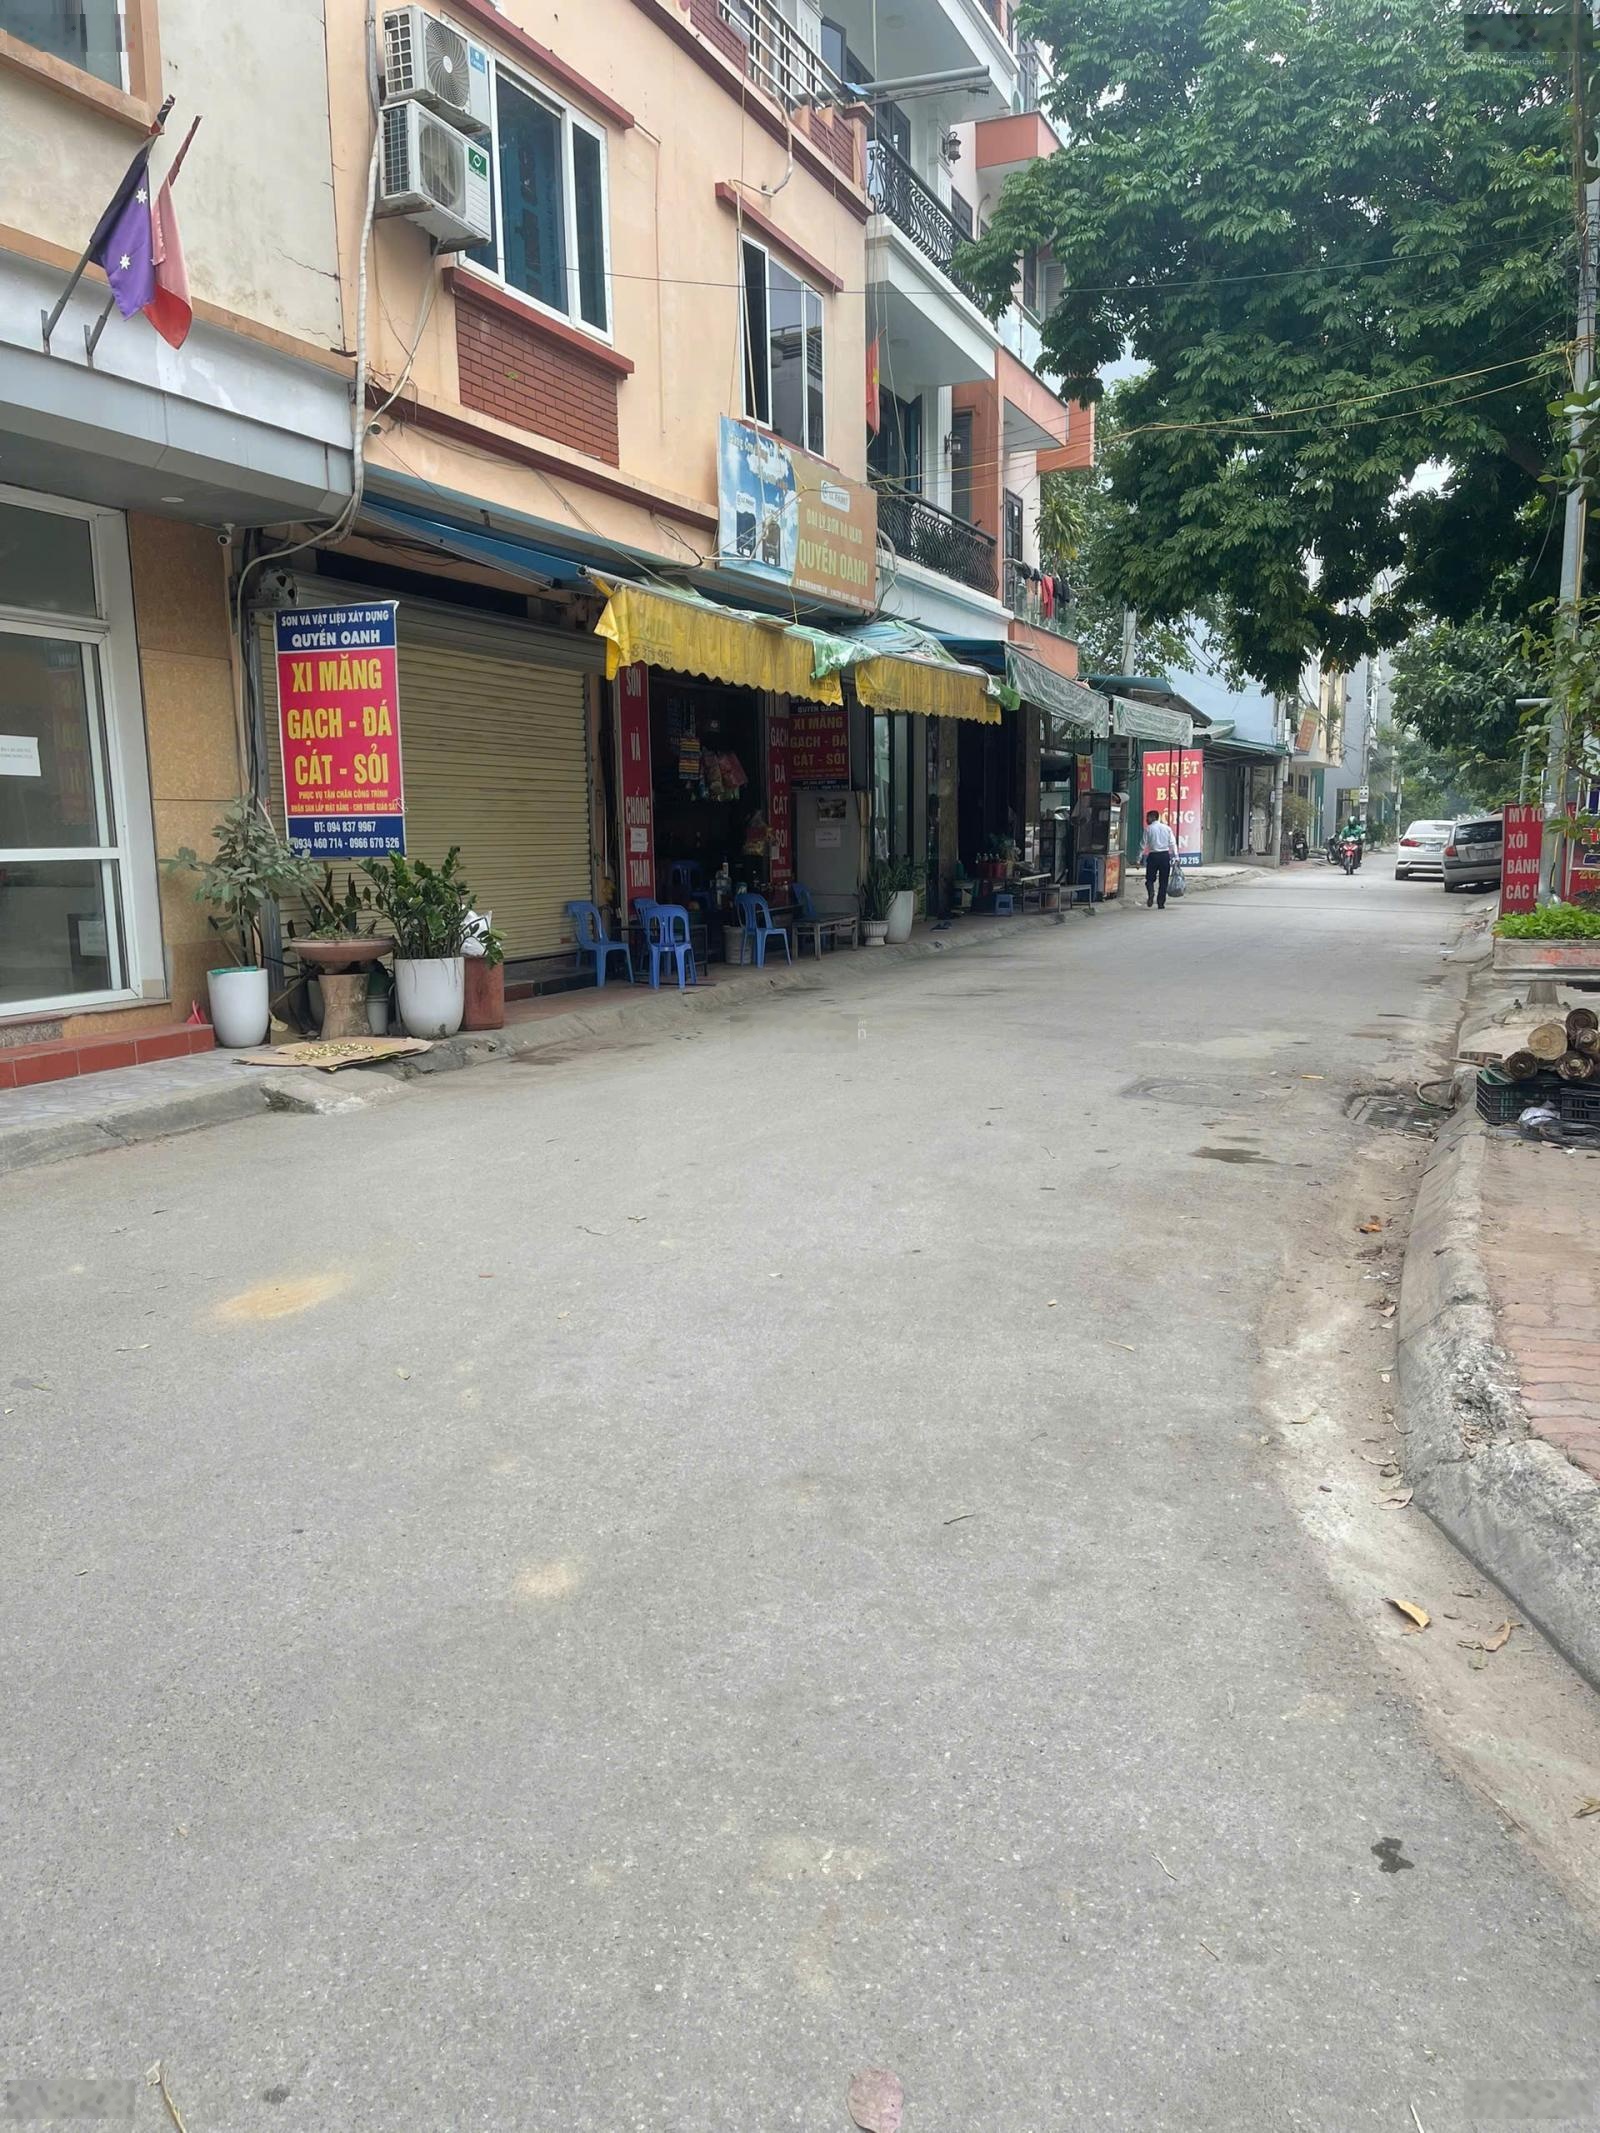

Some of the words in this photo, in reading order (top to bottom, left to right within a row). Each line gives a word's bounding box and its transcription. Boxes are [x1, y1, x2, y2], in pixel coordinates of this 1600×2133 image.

[839, 553, 868, 588] OANH
[340, 629, 380, 645] OANH
[291, 661, 313, 693] XI
[319, 653, 383, 692] MĂNG
[287, 708, 343, 746] GẠCH
[362, 699, 393, 737] ĐÁ
[294, 749, 333, 785] CÁT
[353, 743, 389, 784] SỎI
[314, 822, 326, 833] ĐT:
[327, 821, 341, 833] 094
[342, 821, 356, 832] 837
[358, 821, 376, 832] 9967
[313, 838, 328, 849] 460
[329, 838, 343, 848] 714
[349, 837, 368, 848] 0966
[369, 837, 384, 848] 670
[385, 837, 400, 848] 526
[1508, 830, 1528, 849] XÔI
[1188, 856, 1200, 865] 215
[1506, 856, 1539, 875] BÁNH
[1505, 881, 1530, 900] CÁC
